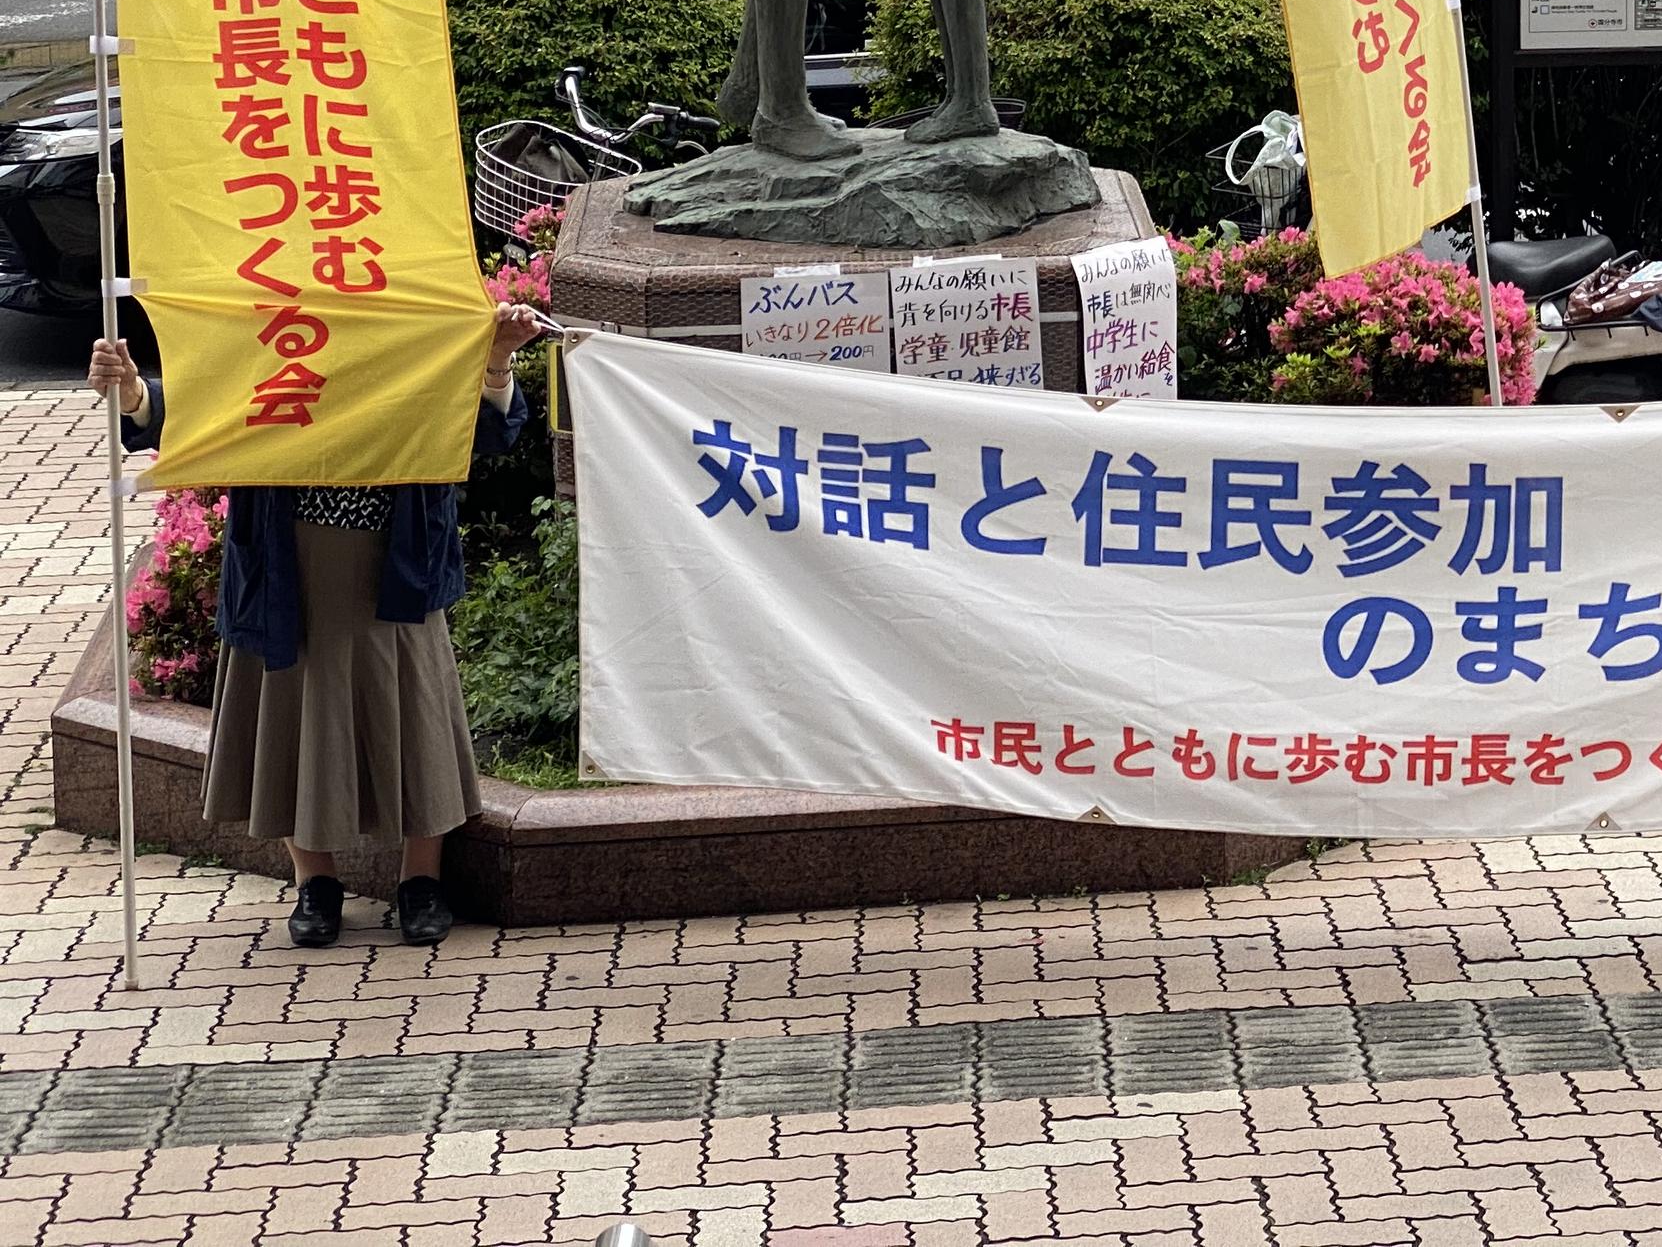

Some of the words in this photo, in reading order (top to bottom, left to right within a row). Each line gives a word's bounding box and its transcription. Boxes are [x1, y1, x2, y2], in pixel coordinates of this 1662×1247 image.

[895, 267, 1028, 294] みんなの願いに
[1080, 248, 1173, 283] みんなの願いに
[749, 280, 858, 314] ぶんバス
[896, 291, 1034, 328] 背を向ける市長
[746, 313, 884, 348] いきなり2倍化
[1086, 318, 1159, 360] 中学生に
[829, 345, 874, 361] 200円
[691, 417, 1566, 578] 対話と住民参加
